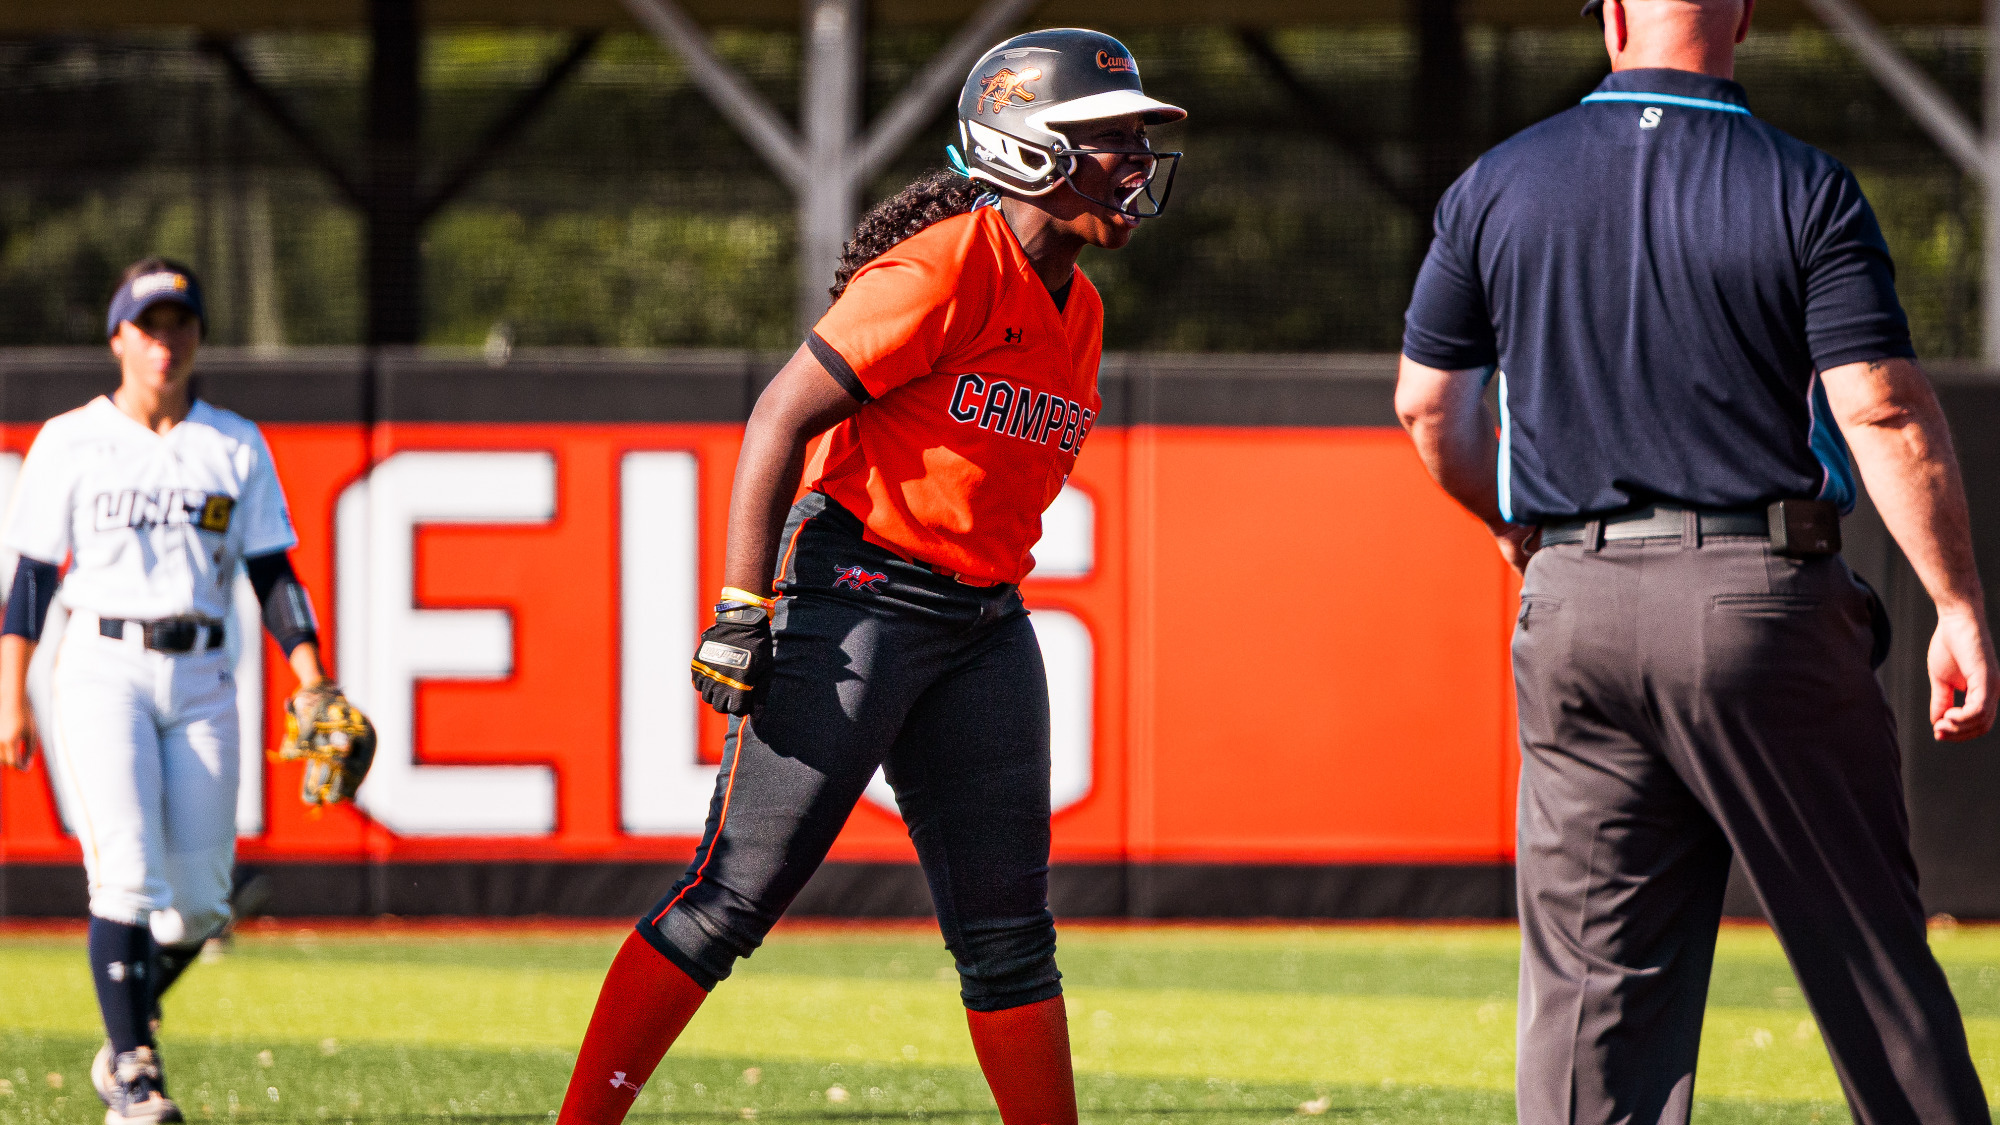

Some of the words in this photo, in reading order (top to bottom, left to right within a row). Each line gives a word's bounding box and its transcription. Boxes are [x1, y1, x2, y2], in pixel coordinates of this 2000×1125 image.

[1097, 50, 1134, 72] Camp
[1639, 106, 1664, 130] S
[947, 373, 1096, 458] CAMPBE
